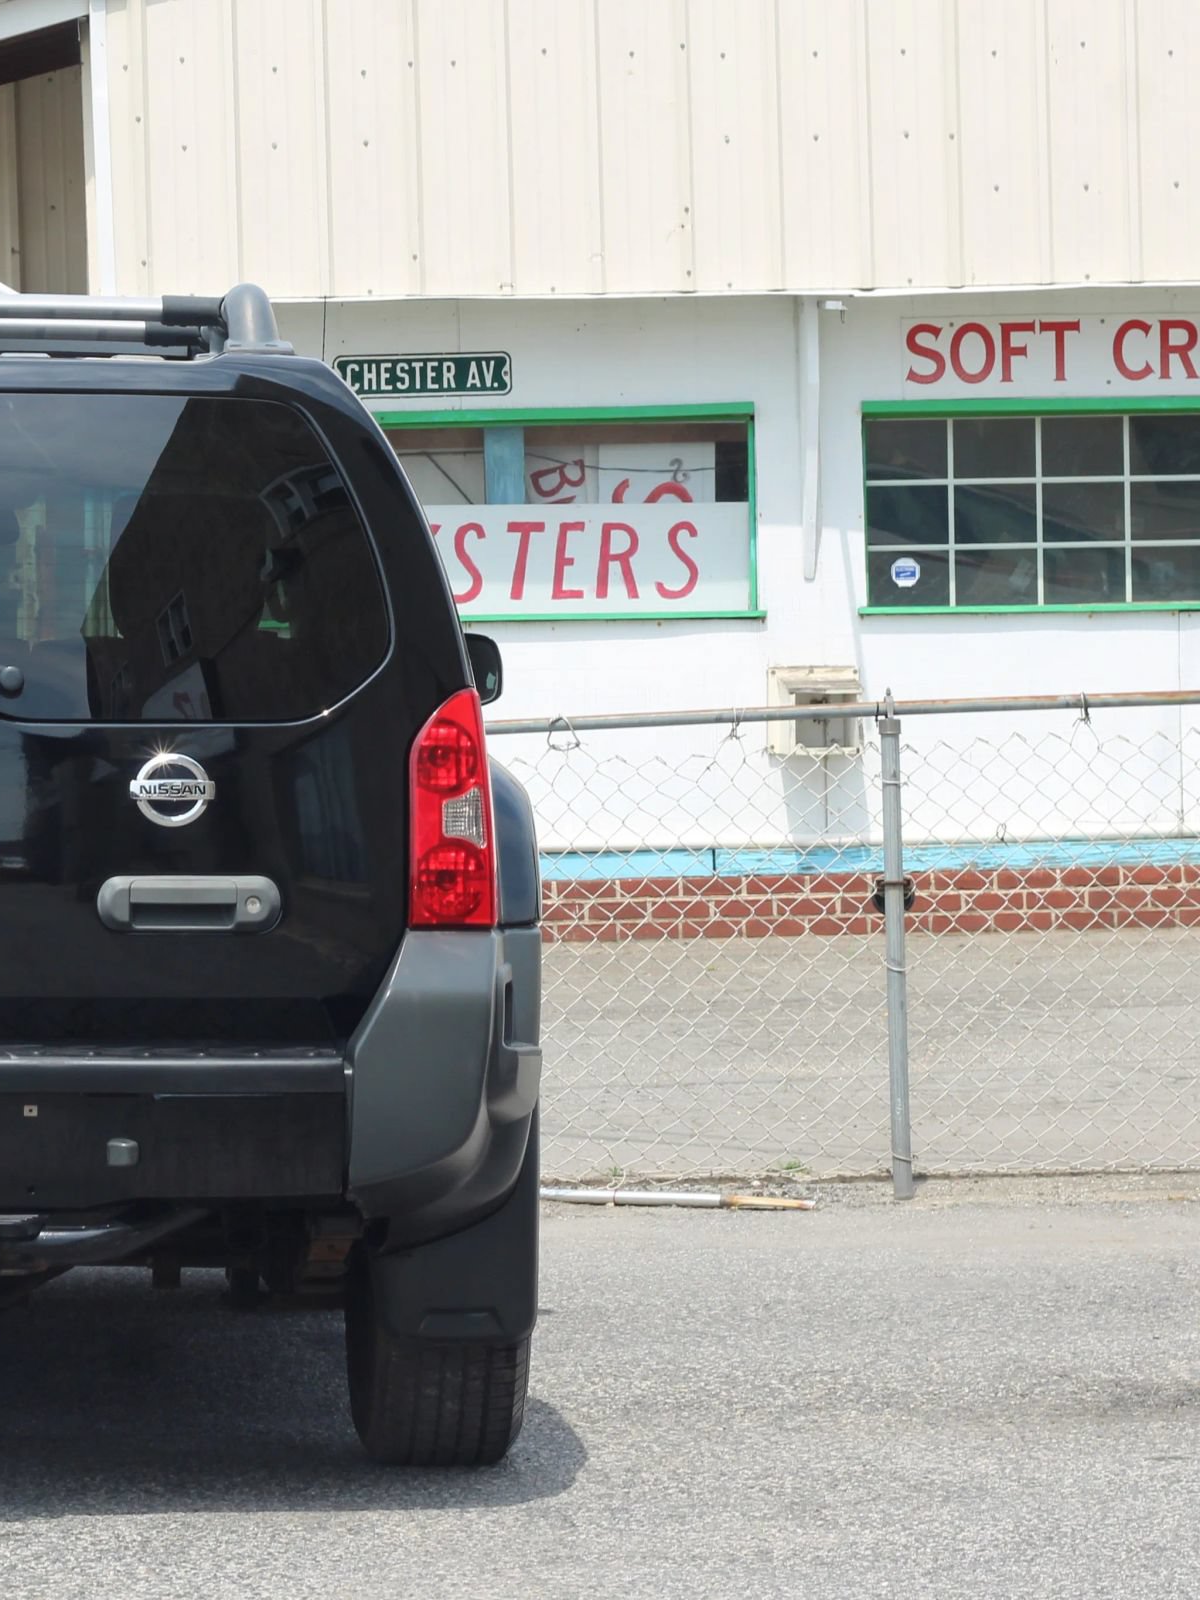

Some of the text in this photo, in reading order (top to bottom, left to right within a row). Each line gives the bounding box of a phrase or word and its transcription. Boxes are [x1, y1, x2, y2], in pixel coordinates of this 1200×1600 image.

[346, 359, 499, 393] CHESTER AV.
[905, 319, 1080, 384] SOFT
[430, 520, 699, 605] STERS
[139, 784, 207, 796] NISSAN
